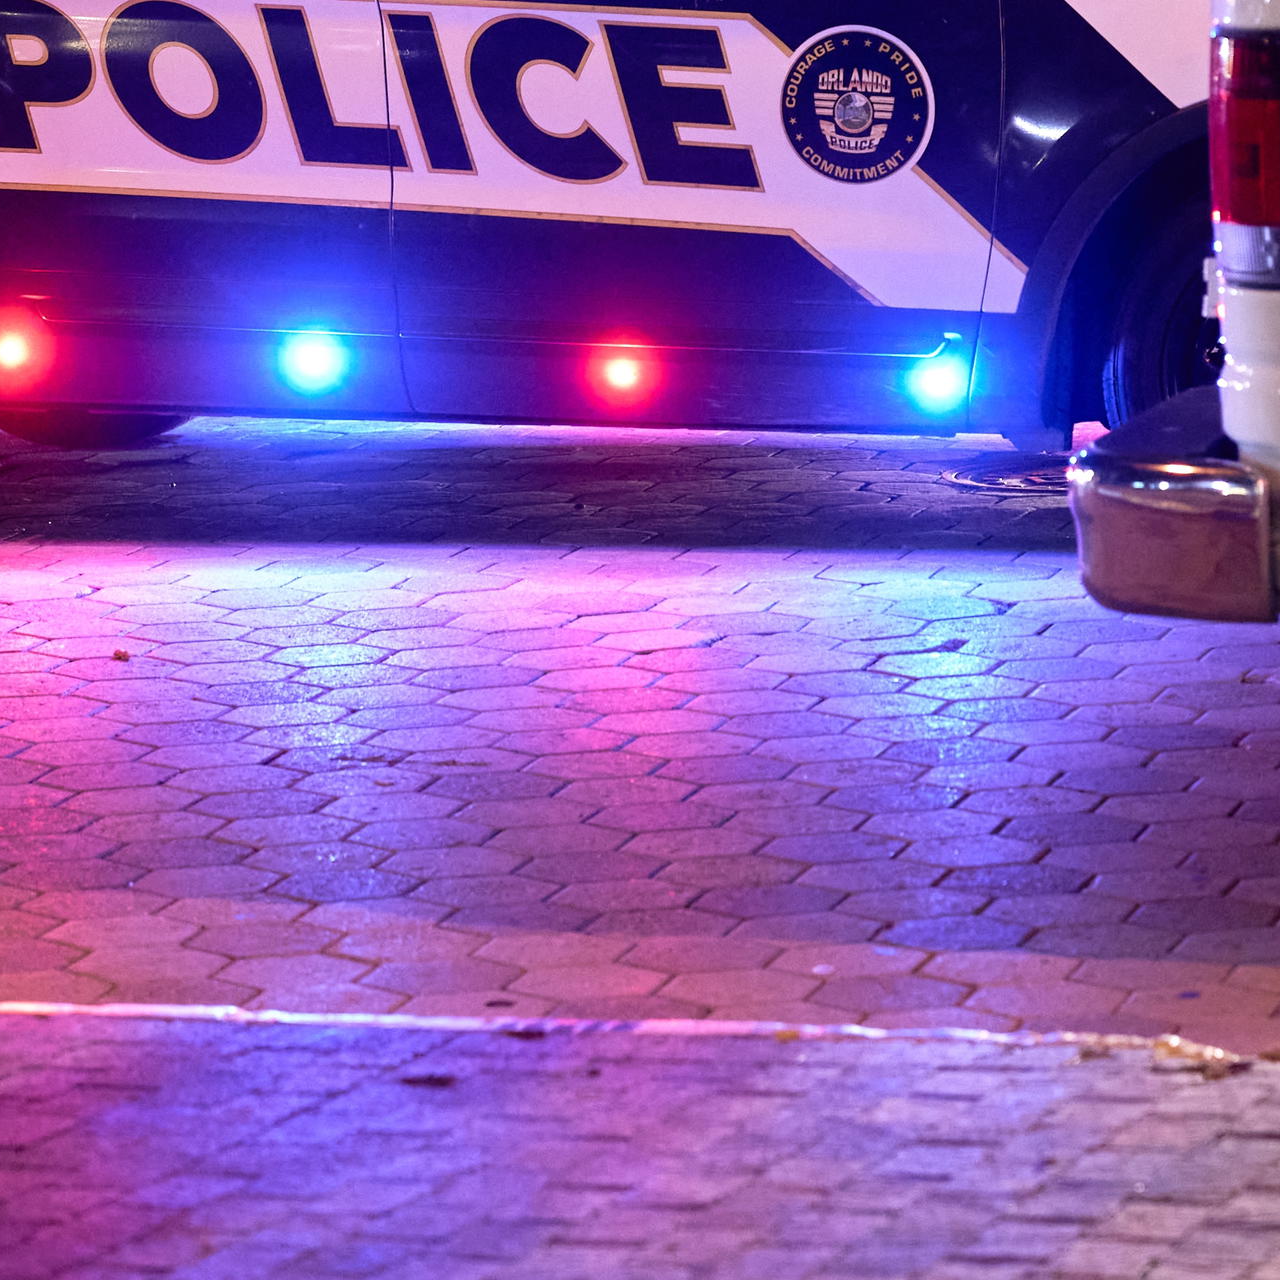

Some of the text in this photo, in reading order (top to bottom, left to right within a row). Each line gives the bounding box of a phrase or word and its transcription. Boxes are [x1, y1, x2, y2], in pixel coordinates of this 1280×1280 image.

[785, 39, 836, 109] COURAGE
[818, 67, 892, 94] ORLANDO
[878, 42, 924, 99] PRIDE
[829, 135, 876, 151] POLICE
[802, 145, 905, 180] COMMITMENT
